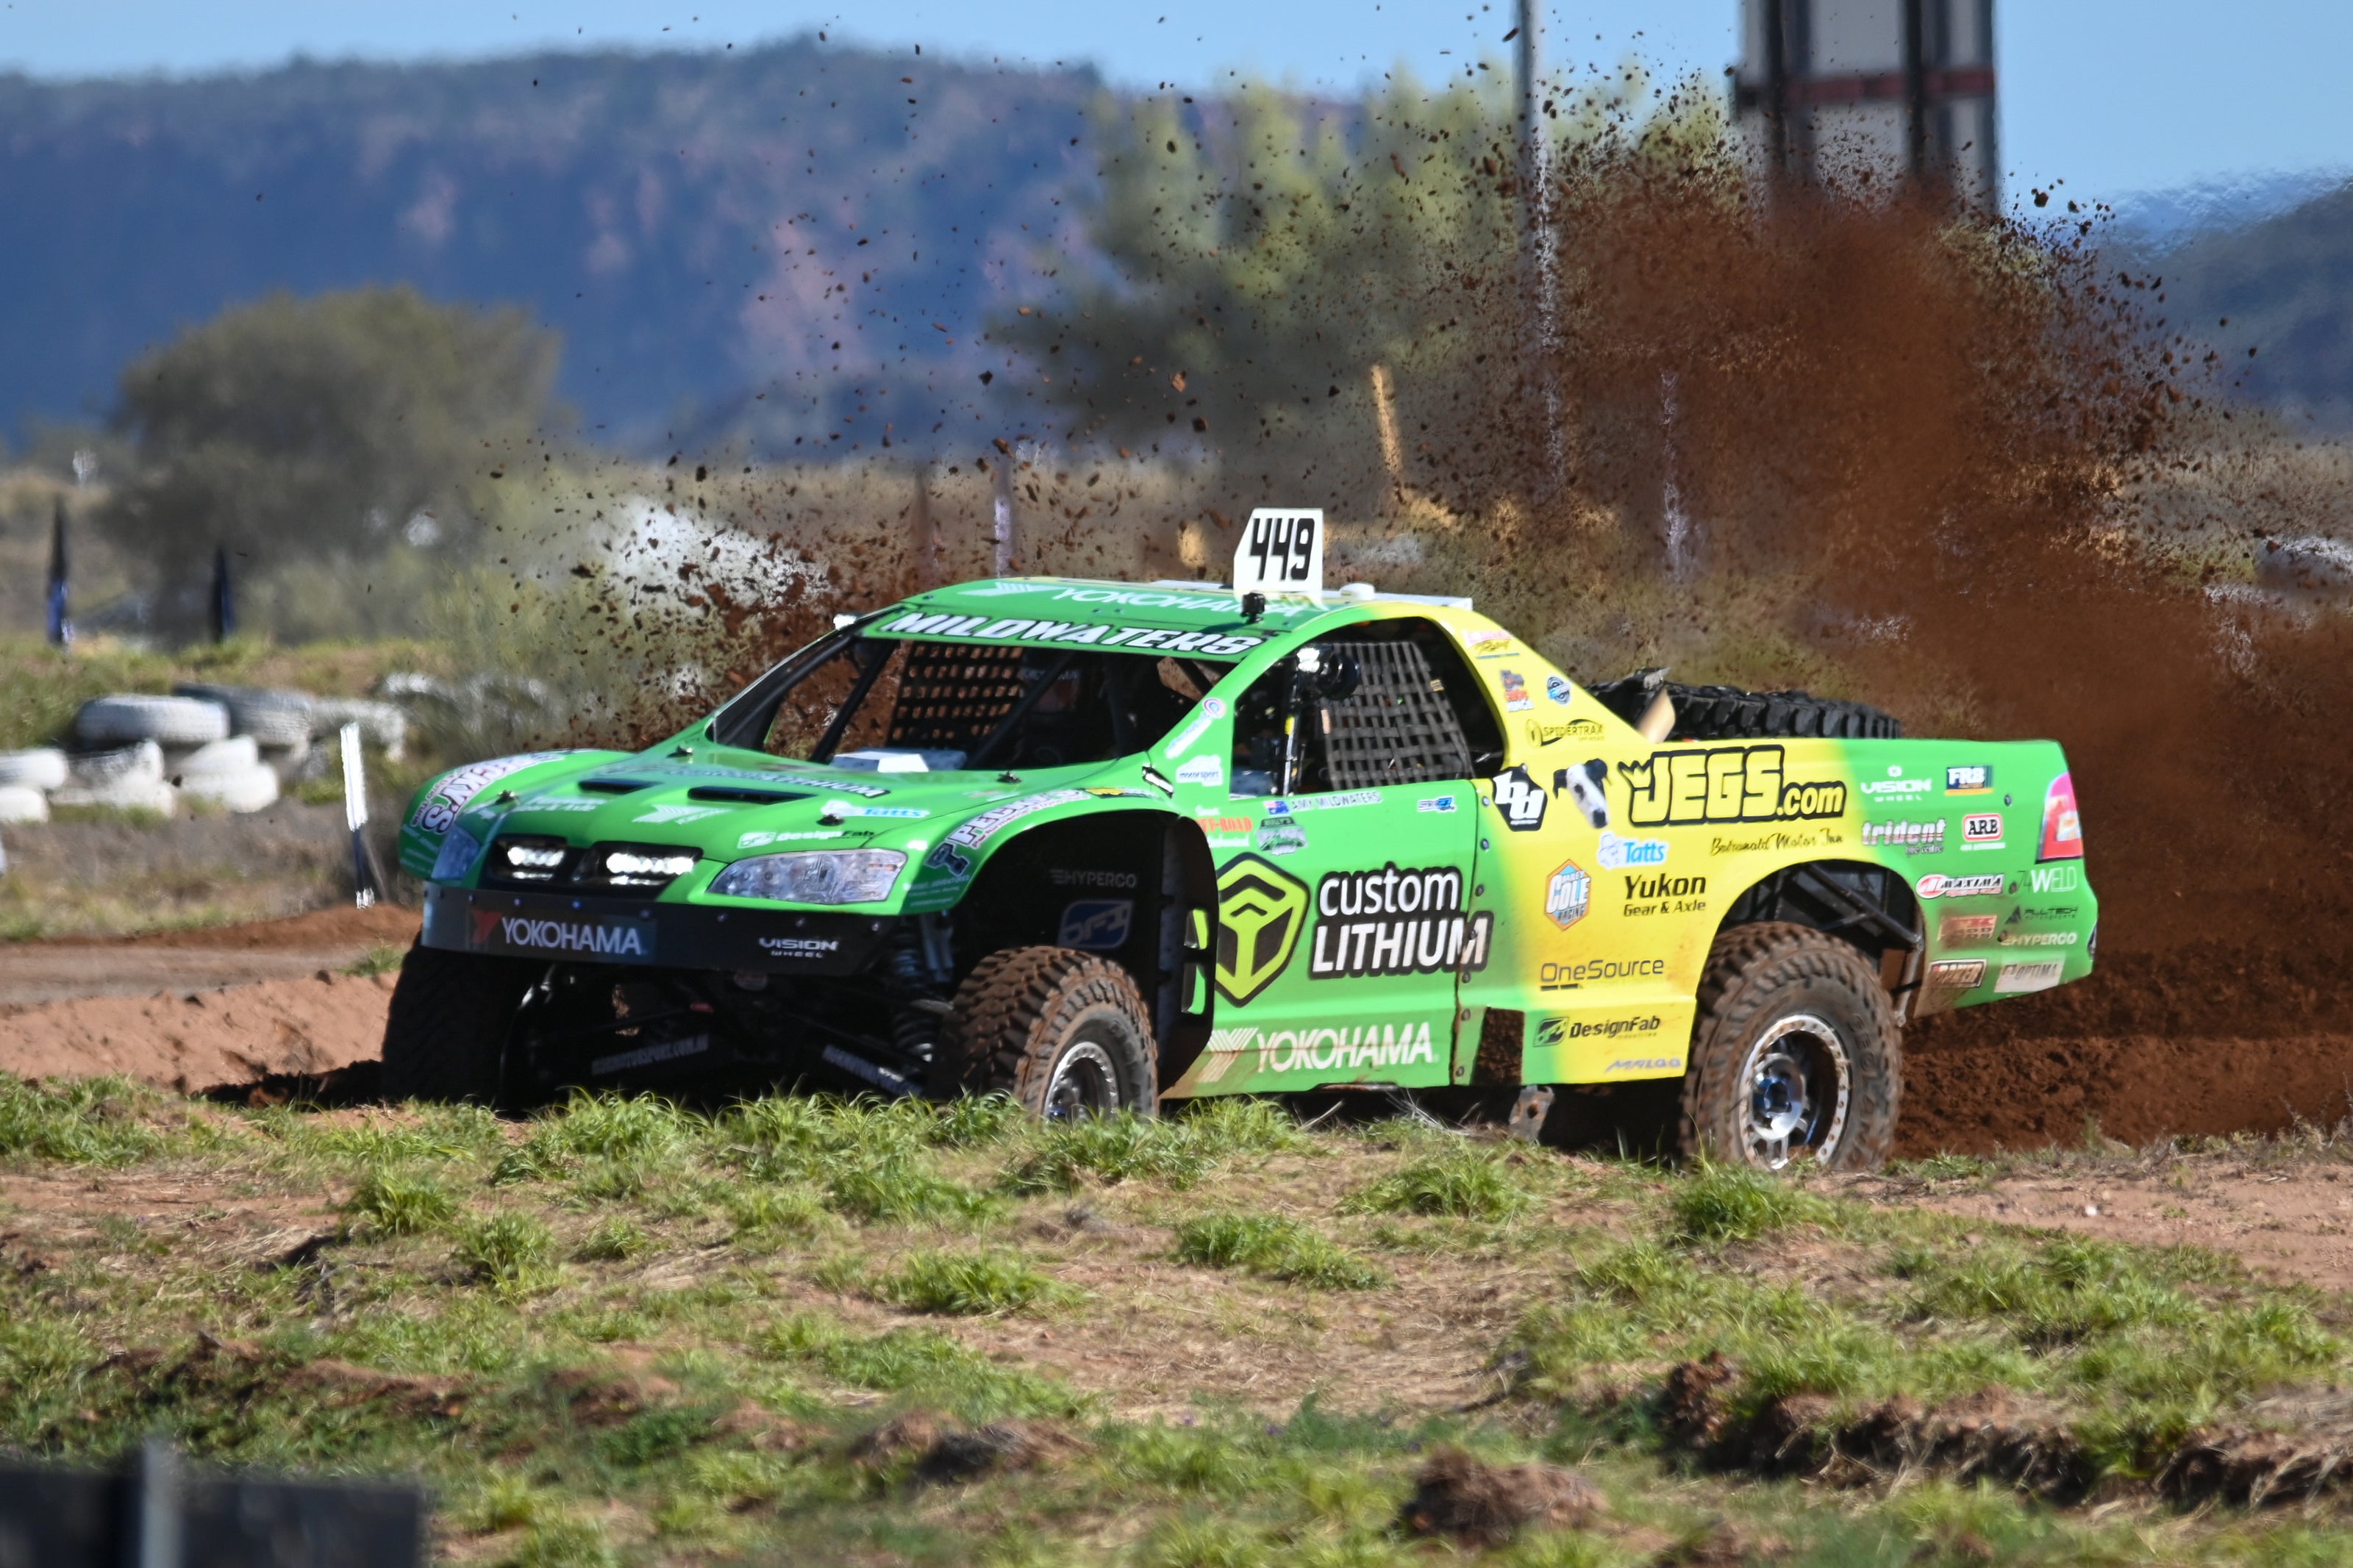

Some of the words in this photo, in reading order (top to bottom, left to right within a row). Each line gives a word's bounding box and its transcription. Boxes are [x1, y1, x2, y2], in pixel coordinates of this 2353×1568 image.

[1249, 517, 1315, 581] 449
[880, 612, 1265, 657] MILDWATERS
[1543, 723, 1604, 737] SPIDERTRAX
[1628, 745, 1847, 826] JEGS.com
[1860, 778, 1932, 794] VISION
[1861, 817, 1946, 846] trident
[1968, 819, 1999, 836] ARB
[1623, 841, 1665, 863] Tatts
[1319, 868, 1459, 917] custom
[1624, 873, 1707, 900] Yukon
[1939, 874, 2004, 890] MAXIMA
[1623, 903, 1657, 917] Gear
[1659, 901, 1670, 914] &
[1673, 899, 1706, 913] Axle
[501, 916, 642, 956] YOKOHAMA
[757, 937, 840, 951] VISION
[1312, 917, 1489, 973] LITHIUM
[770, 950, 824, 959] WHEEL
[1540, 959, 1665, 983] OneSource
[1256, 1022, 1434, 1074] YOKOHAMA
